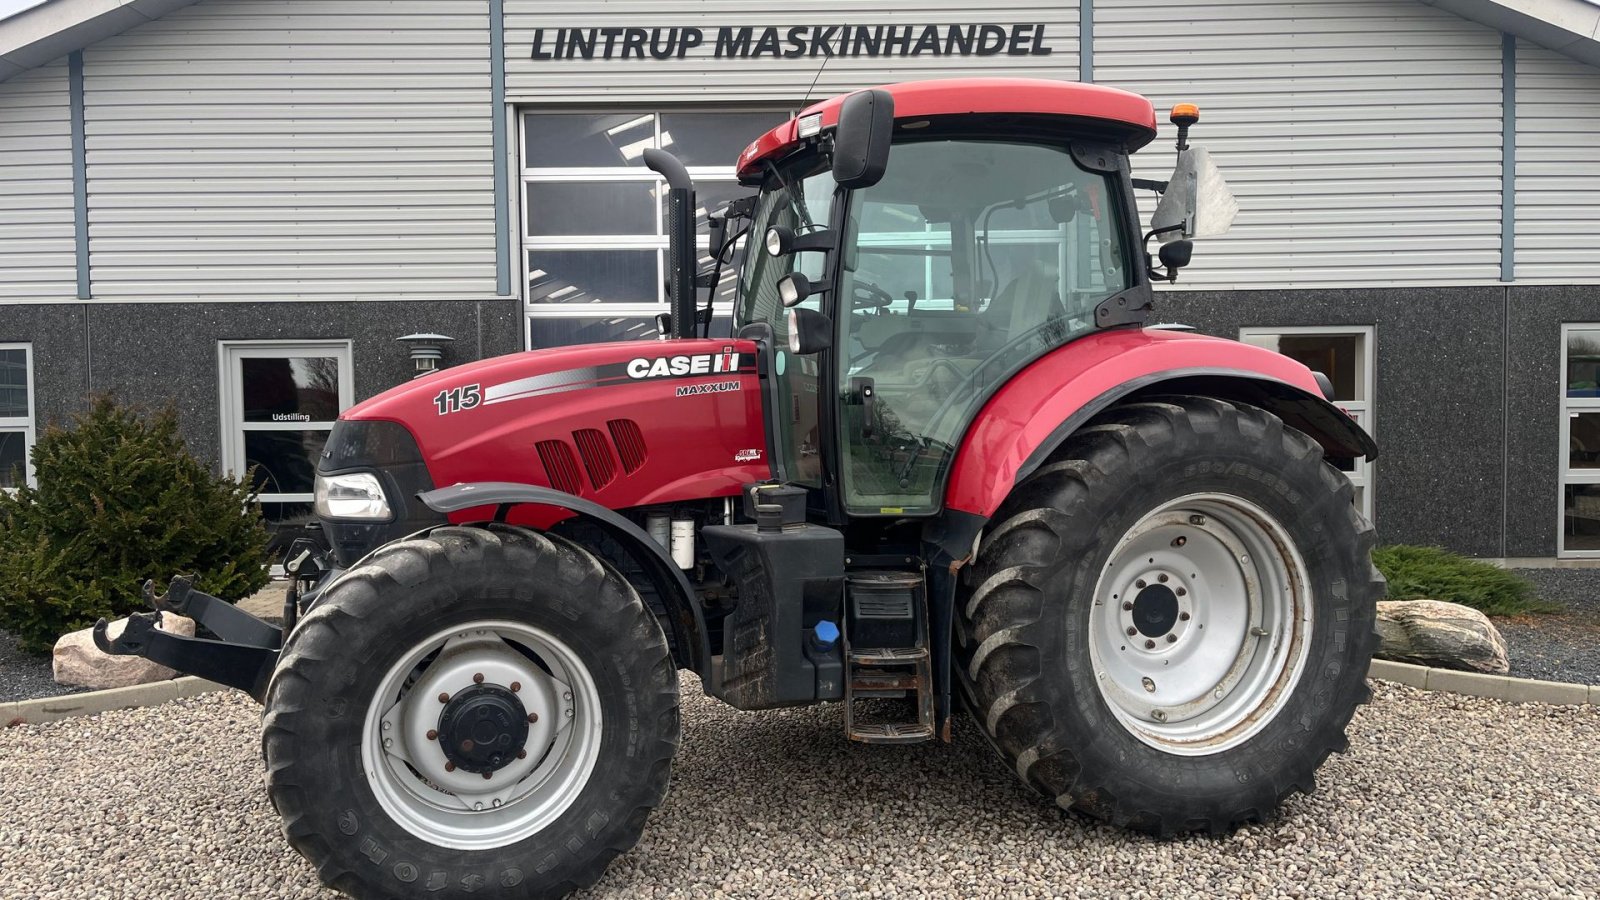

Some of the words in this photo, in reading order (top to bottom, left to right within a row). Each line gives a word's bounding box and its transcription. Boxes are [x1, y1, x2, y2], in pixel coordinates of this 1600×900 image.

[531, 28, 703, 60] LINTRUP
[713, 24, 1052, 59] MASKINHANDEL
[627, 355, 711, 378] CASE
[434, 383, 481, 415] 115
[675, 381, 741, 397] MAXXUM
[272, 413, 310, 422] Udstilling
